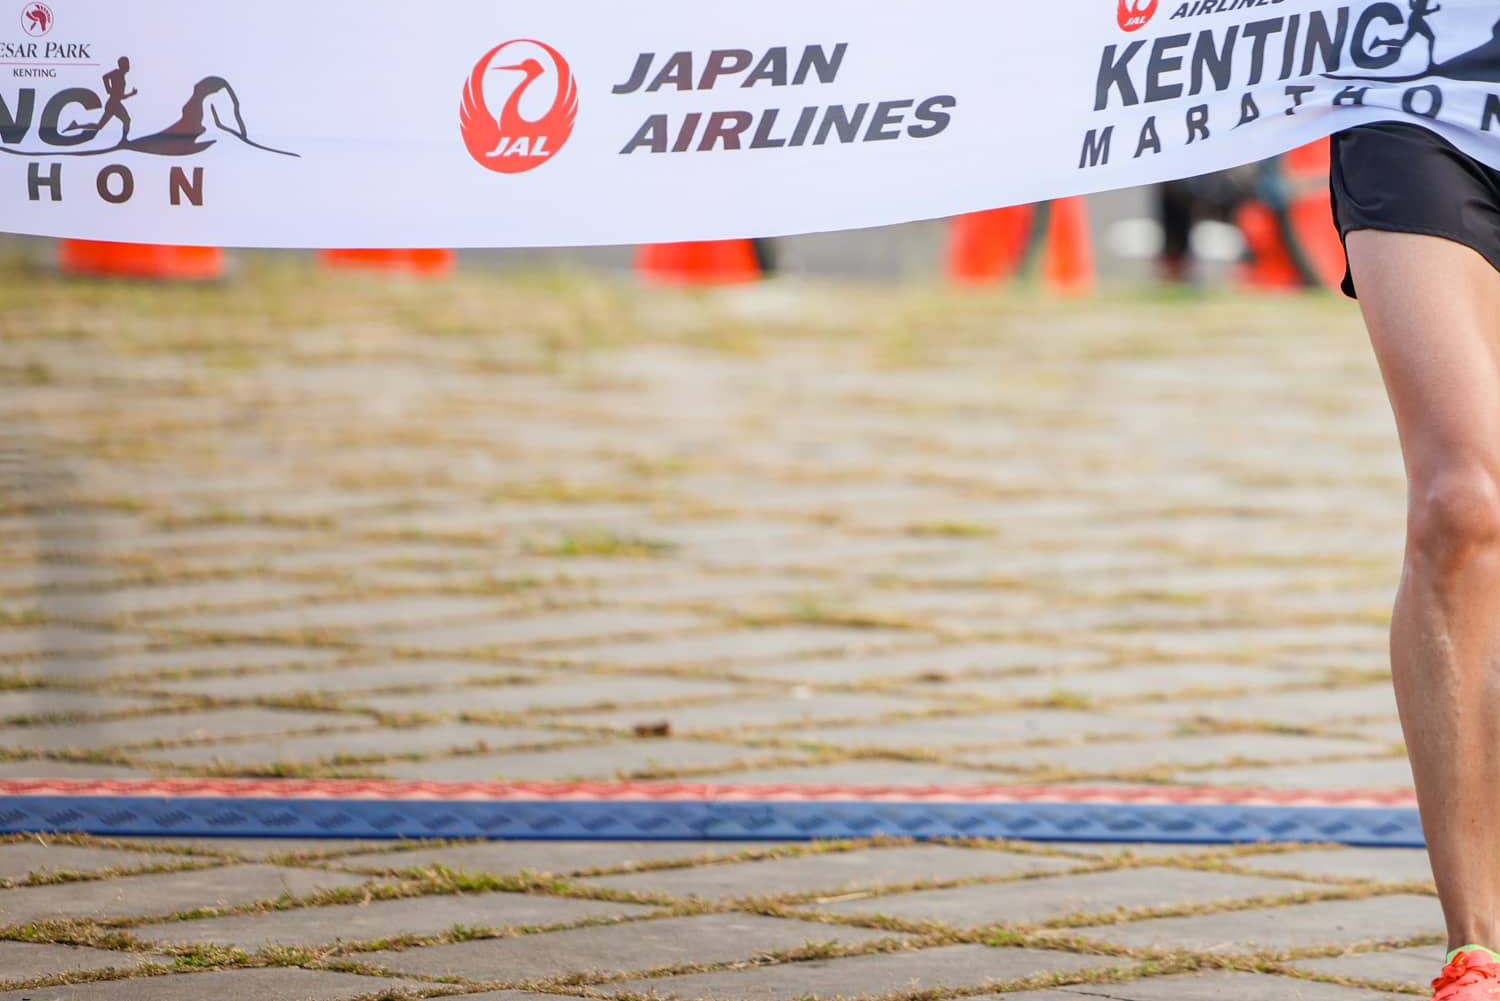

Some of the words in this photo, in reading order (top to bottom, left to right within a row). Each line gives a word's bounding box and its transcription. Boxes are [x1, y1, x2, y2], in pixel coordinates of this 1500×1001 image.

[1124, 15, 1147, 27] JAL
[44, 42, 91, 59] PARK
[1093, 1, 1405, 112] KENTING
[13, 68, 57, 78] KENTING
[611, 42, 849, 95] JAPAN
[618, 94, 957, 155] AIRLINES
[484, 136, 551, 158] JAL
